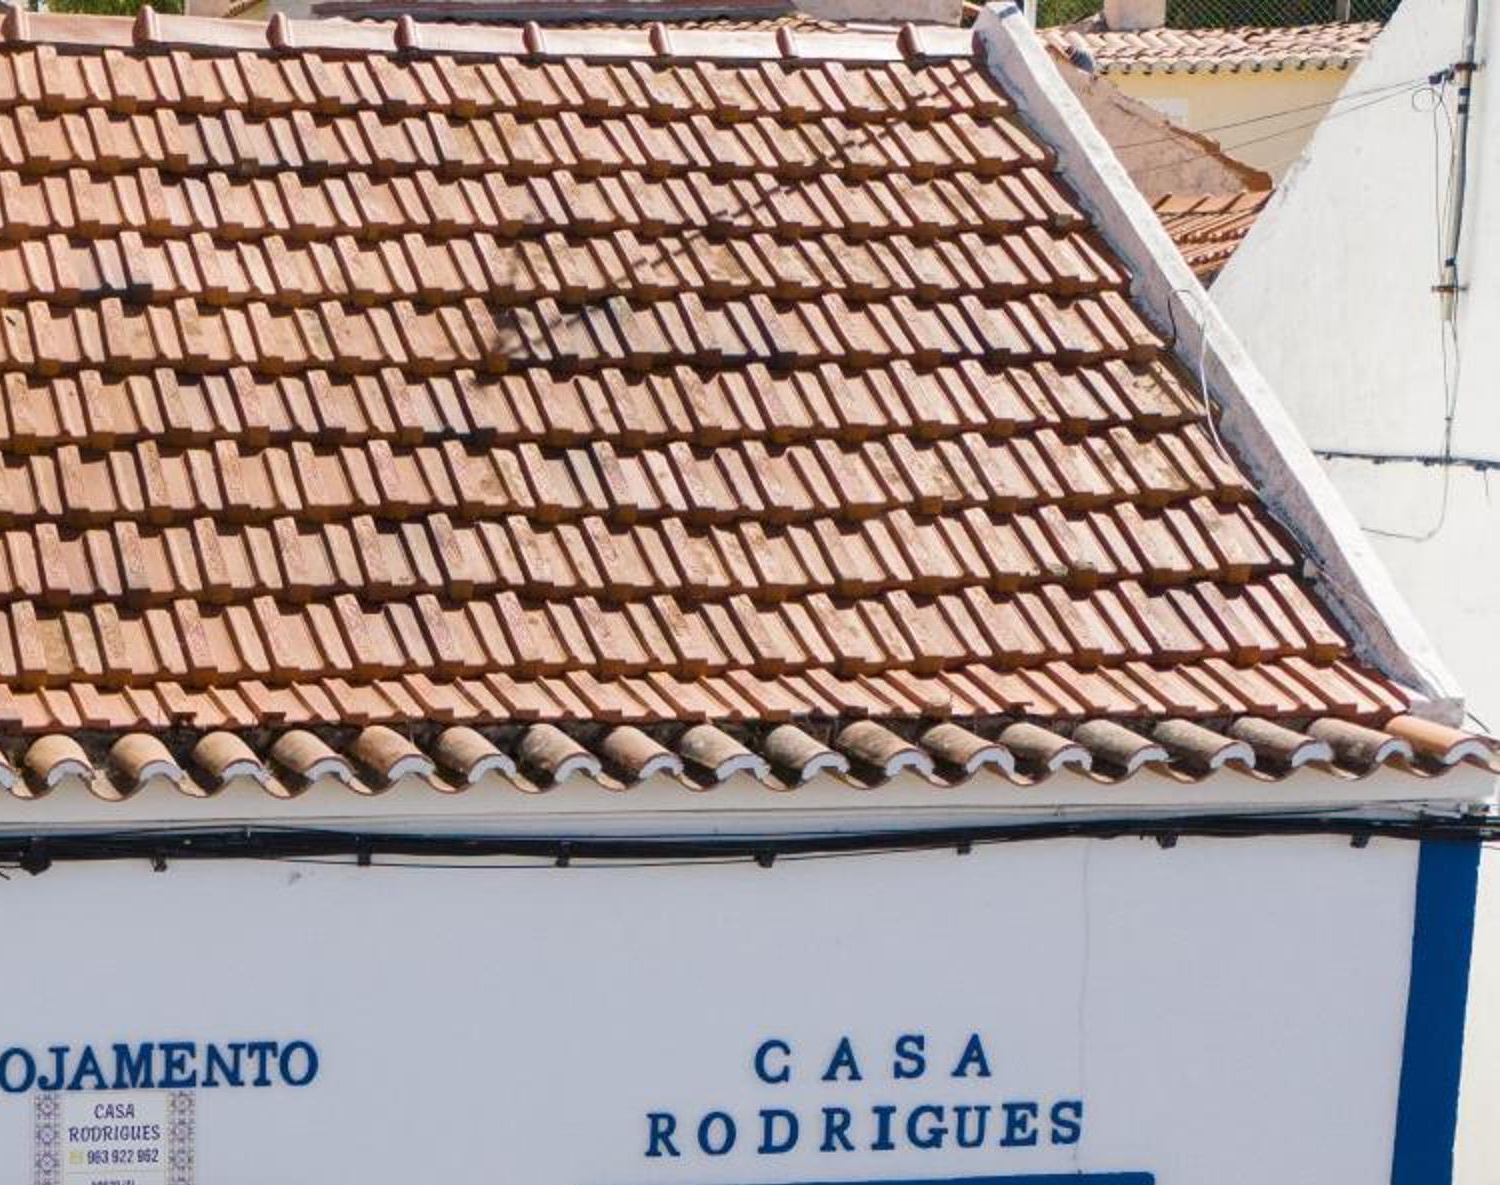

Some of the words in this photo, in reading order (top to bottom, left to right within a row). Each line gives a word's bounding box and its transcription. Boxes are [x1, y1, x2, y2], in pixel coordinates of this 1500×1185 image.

[754, 1033, 991, 1084] CASA
[93, 1103, 135, 1119] CASA
[644, 1100, 1084, 1157] RODRIGUES
[68, 1124, 161, 1143] RODRIGUES
